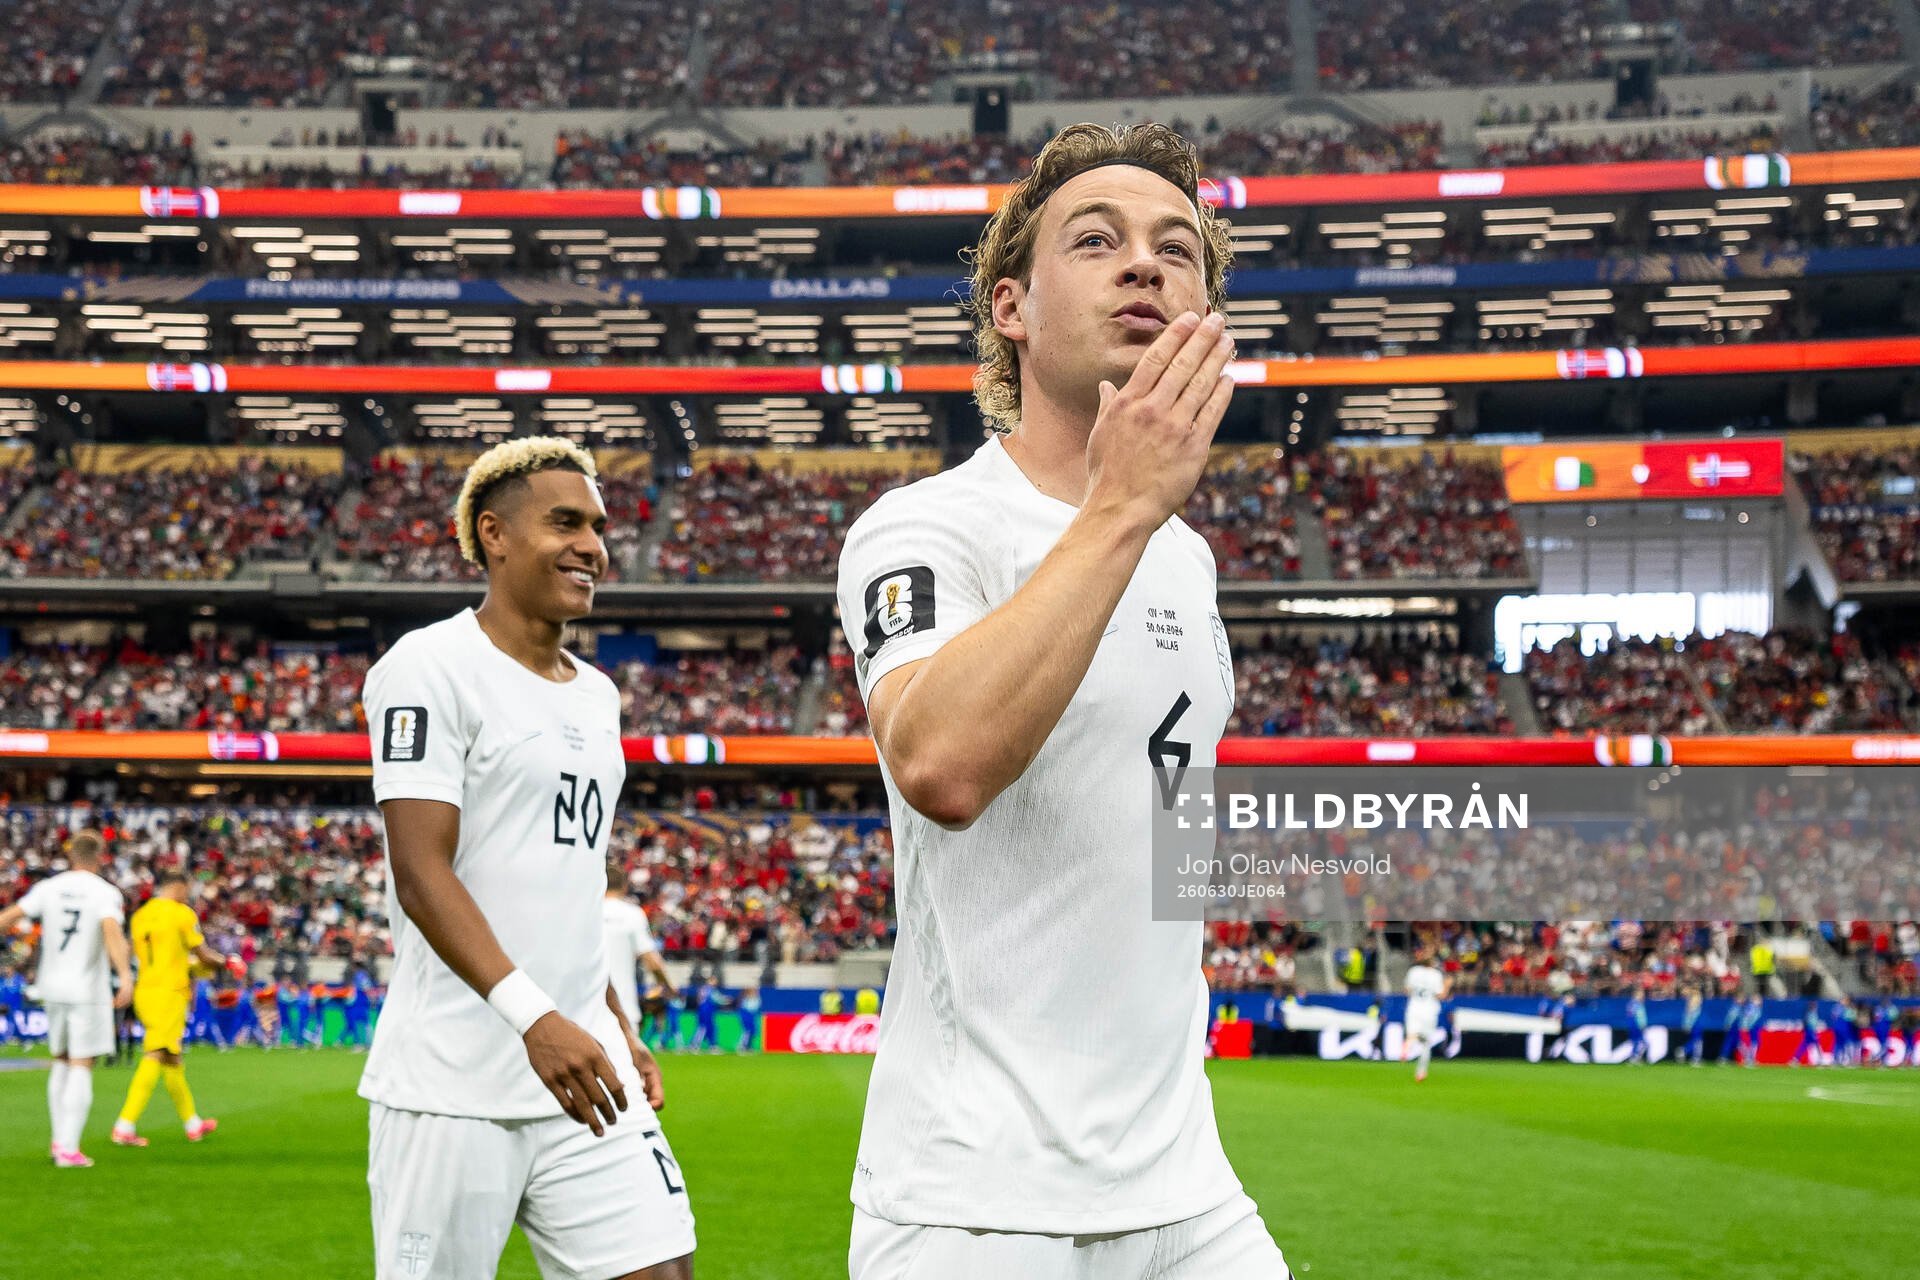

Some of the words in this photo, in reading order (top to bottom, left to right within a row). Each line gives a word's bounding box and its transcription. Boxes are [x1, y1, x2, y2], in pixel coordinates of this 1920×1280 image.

[770, 279, 890, 298] DALLAS
[888, 616, 904, 629] FIFA
[1145, 621, 1184, 637] 30.06.2026
[1155, 638, 1179, 652] DALLAS
[1147, 689, 1193, 811] 6
[554, 770, 604, 849] 20
[60, 910, 81, 951] 7
